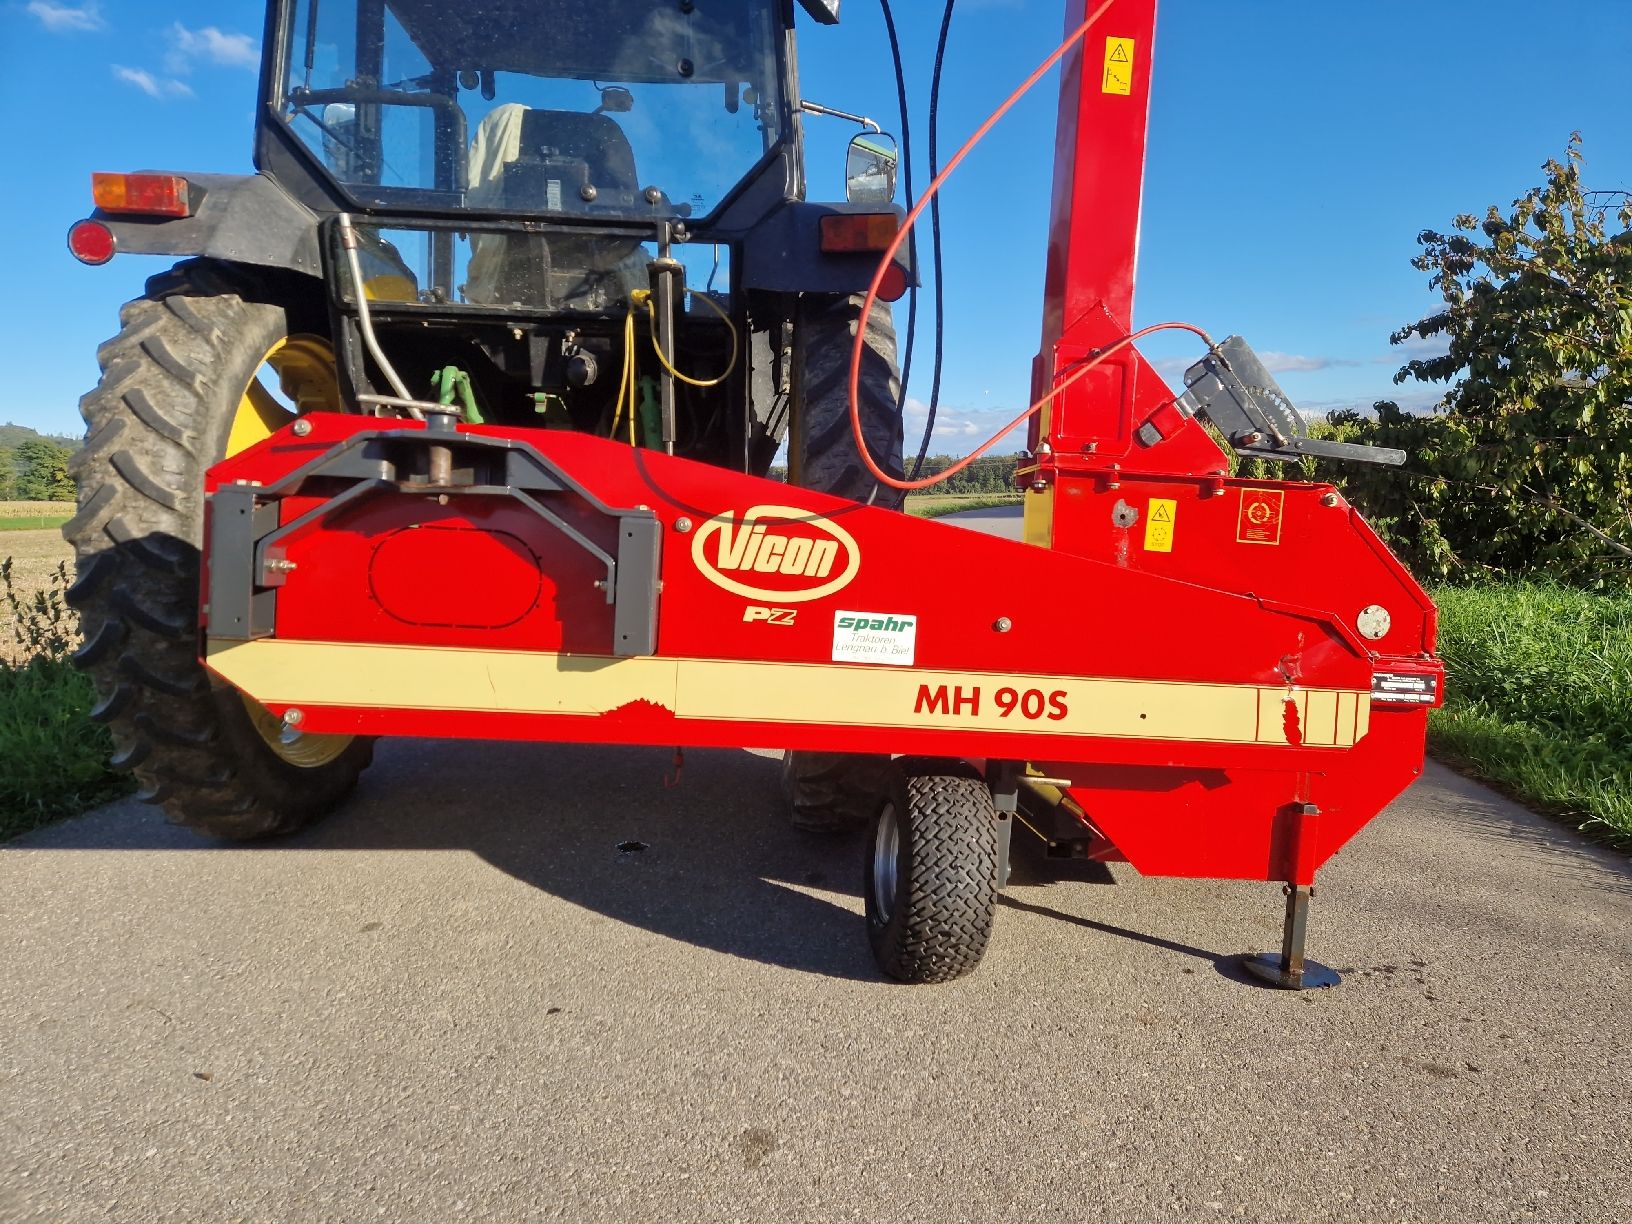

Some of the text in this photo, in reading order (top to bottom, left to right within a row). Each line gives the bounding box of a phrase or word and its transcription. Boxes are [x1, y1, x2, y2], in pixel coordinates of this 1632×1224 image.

[717, 511, 839, 577] Vicon
[837, 616, 914, 632] spahr
[851, 633, 896, 645] Traktoren
[913, 684, 1069, 721] MH 90S
